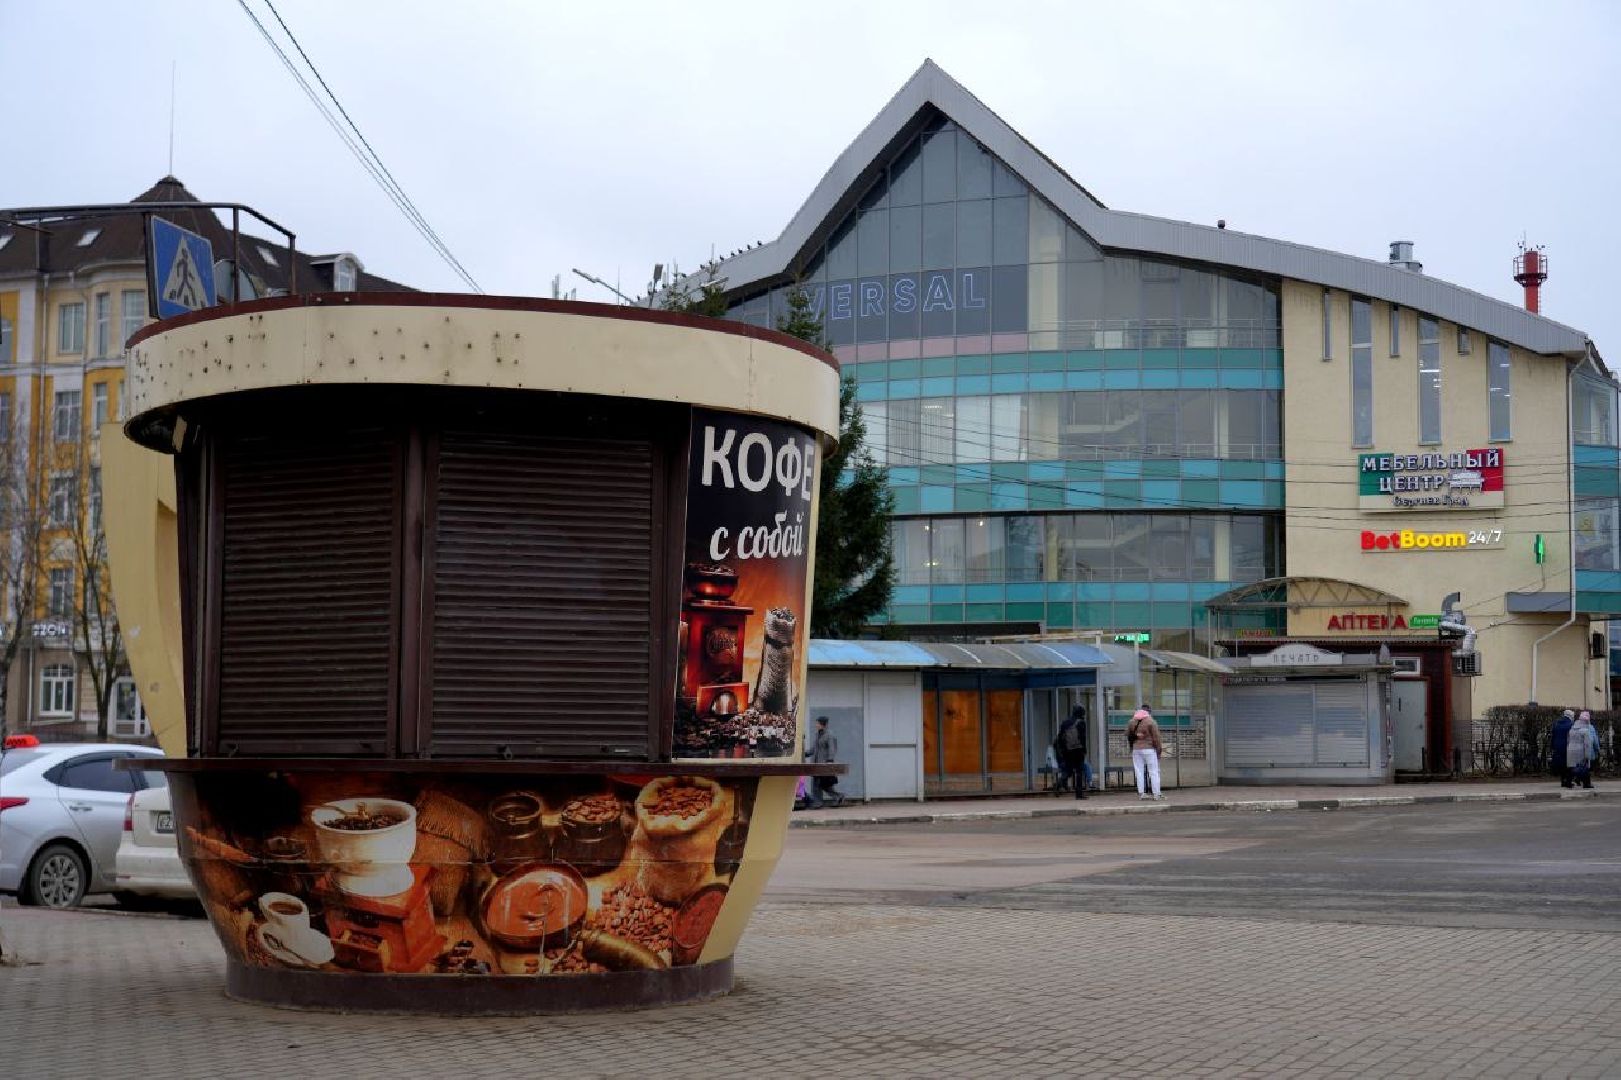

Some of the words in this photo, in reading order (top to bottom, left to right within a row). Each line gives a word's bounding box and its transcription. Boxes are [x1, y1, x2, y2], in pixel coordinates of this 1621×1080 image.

[701, 425, 814, 501] КОФЕ
[1361, 449, 1499, 472] МЕБЕЛЬНЫЙ
[1379, 475, 1444, 494] ЦЕНТР
[737, 510, 804, 560] собой
[1360, 528, 1467, 550] BetBoom
[1468, 530, 1502, 545] 24/7
[1327, 615, 1409, 631] АПТЕКА
